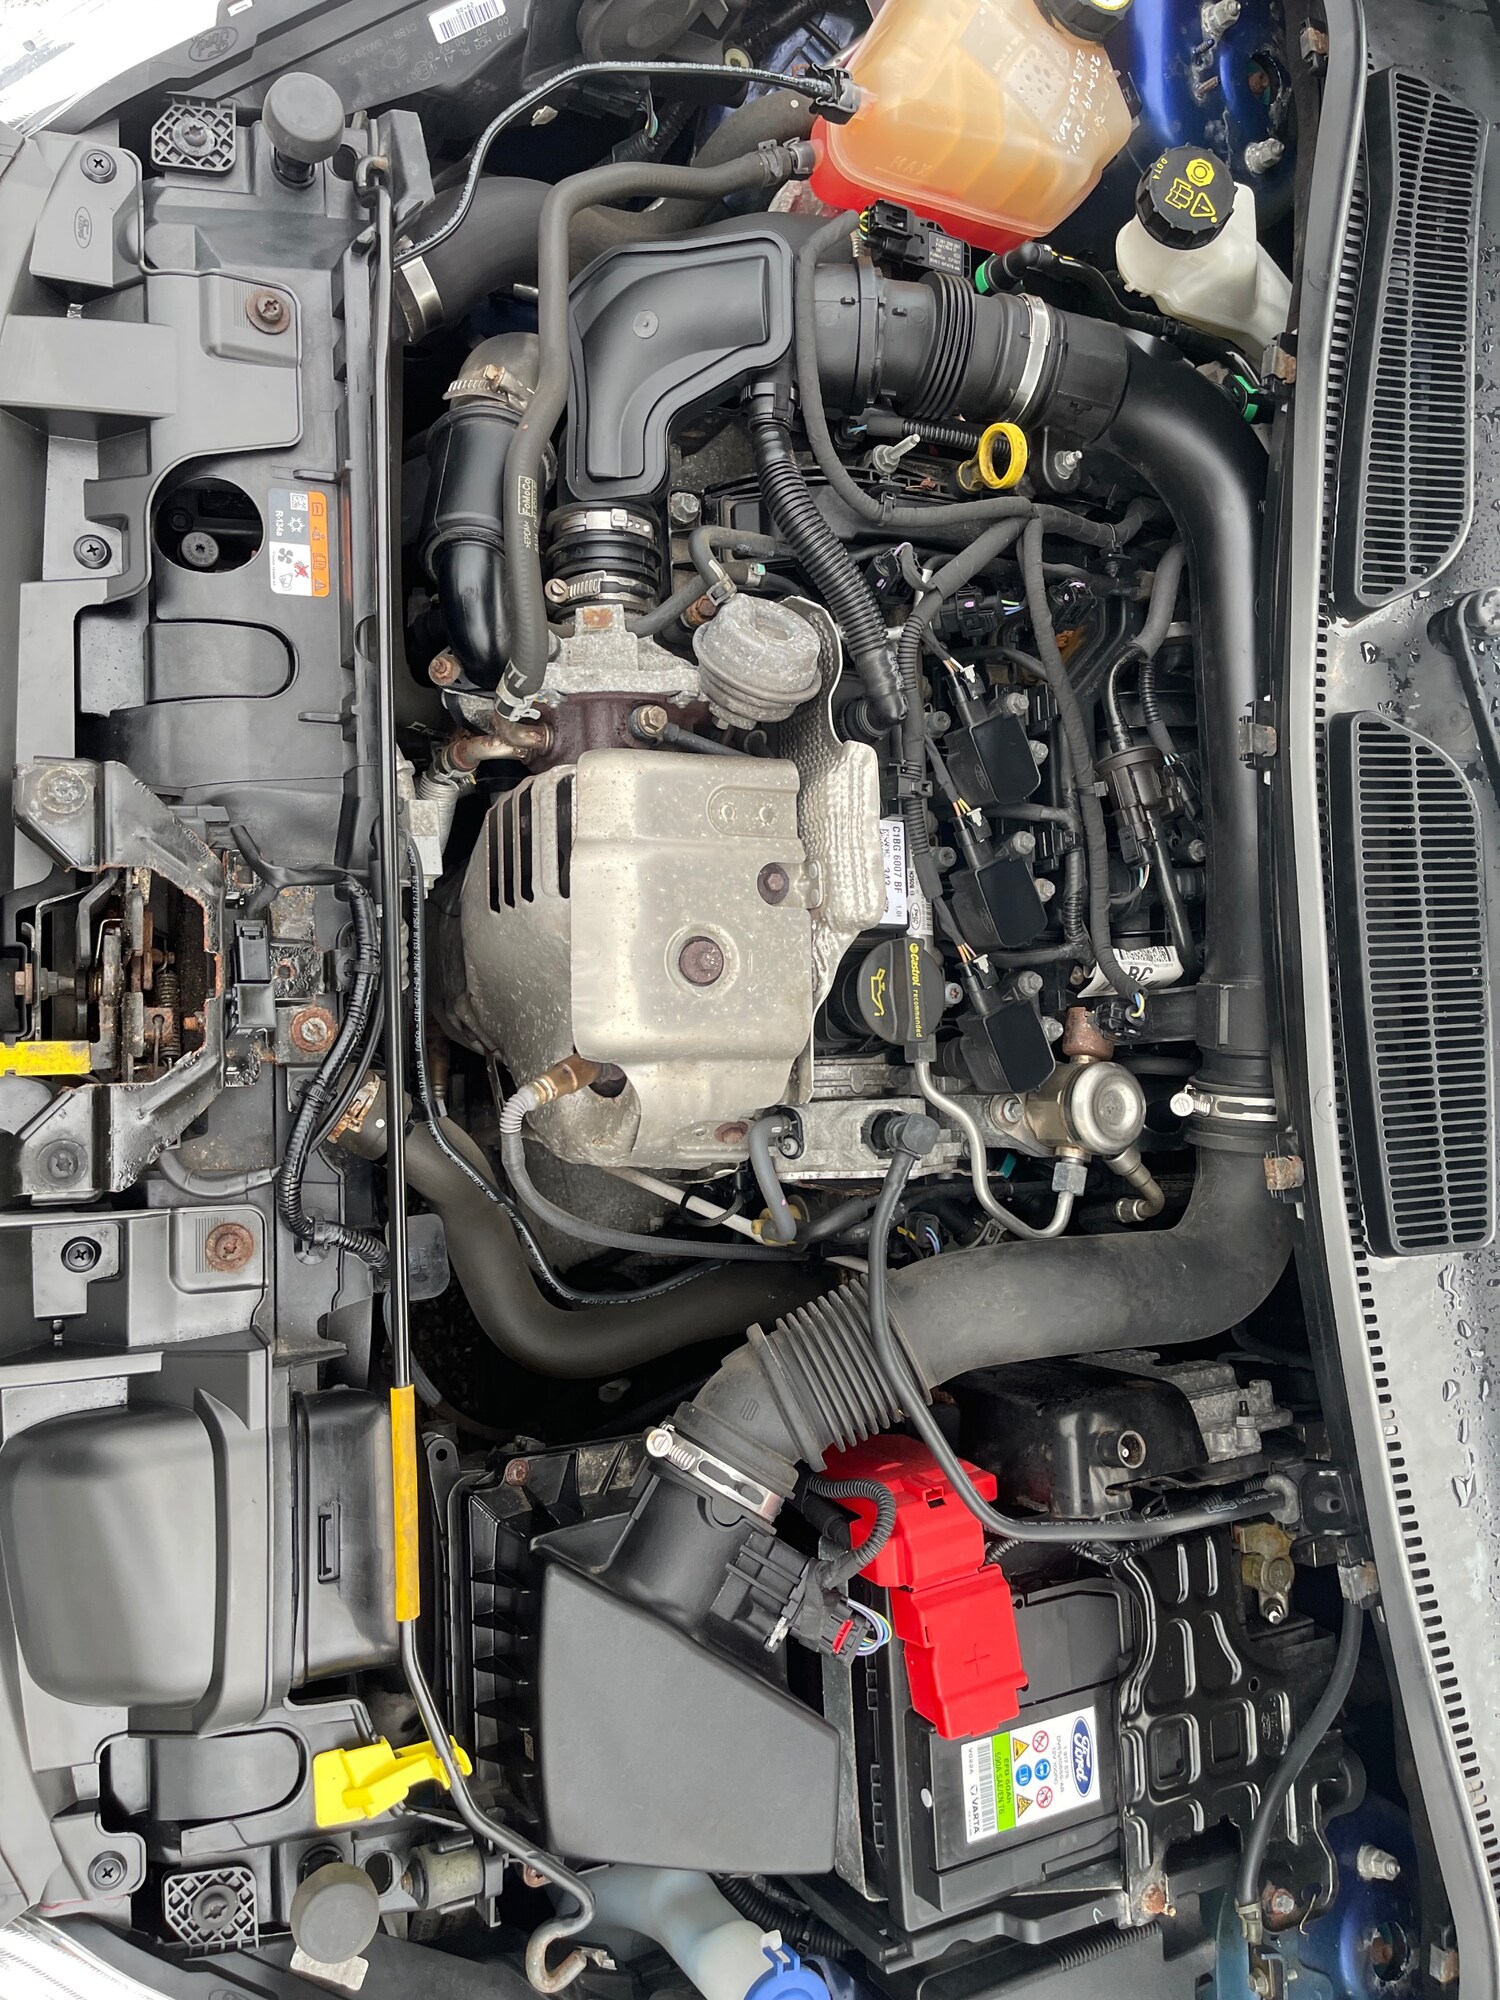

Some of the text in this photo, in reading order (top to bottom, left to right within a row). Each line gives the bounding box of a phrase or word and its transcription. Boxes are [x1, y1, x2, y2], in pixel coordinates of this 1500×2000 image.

[522, 478, 531, 515] FoMoCo
[275, 510, 284, 537] R-134a
[892, 826, 901, 852] C1BG
[893, 854, 902, 878] 6007
[894, 881, 903, 894] BF
[910, 952, 923, 1038] Castrol recommended
[994, 1751, 1005, 1815] 590A SAE/EN T6
[1004, 1778, 1012, 1804] 60Ah
[971, 1797, 980, 1835] VARTA
